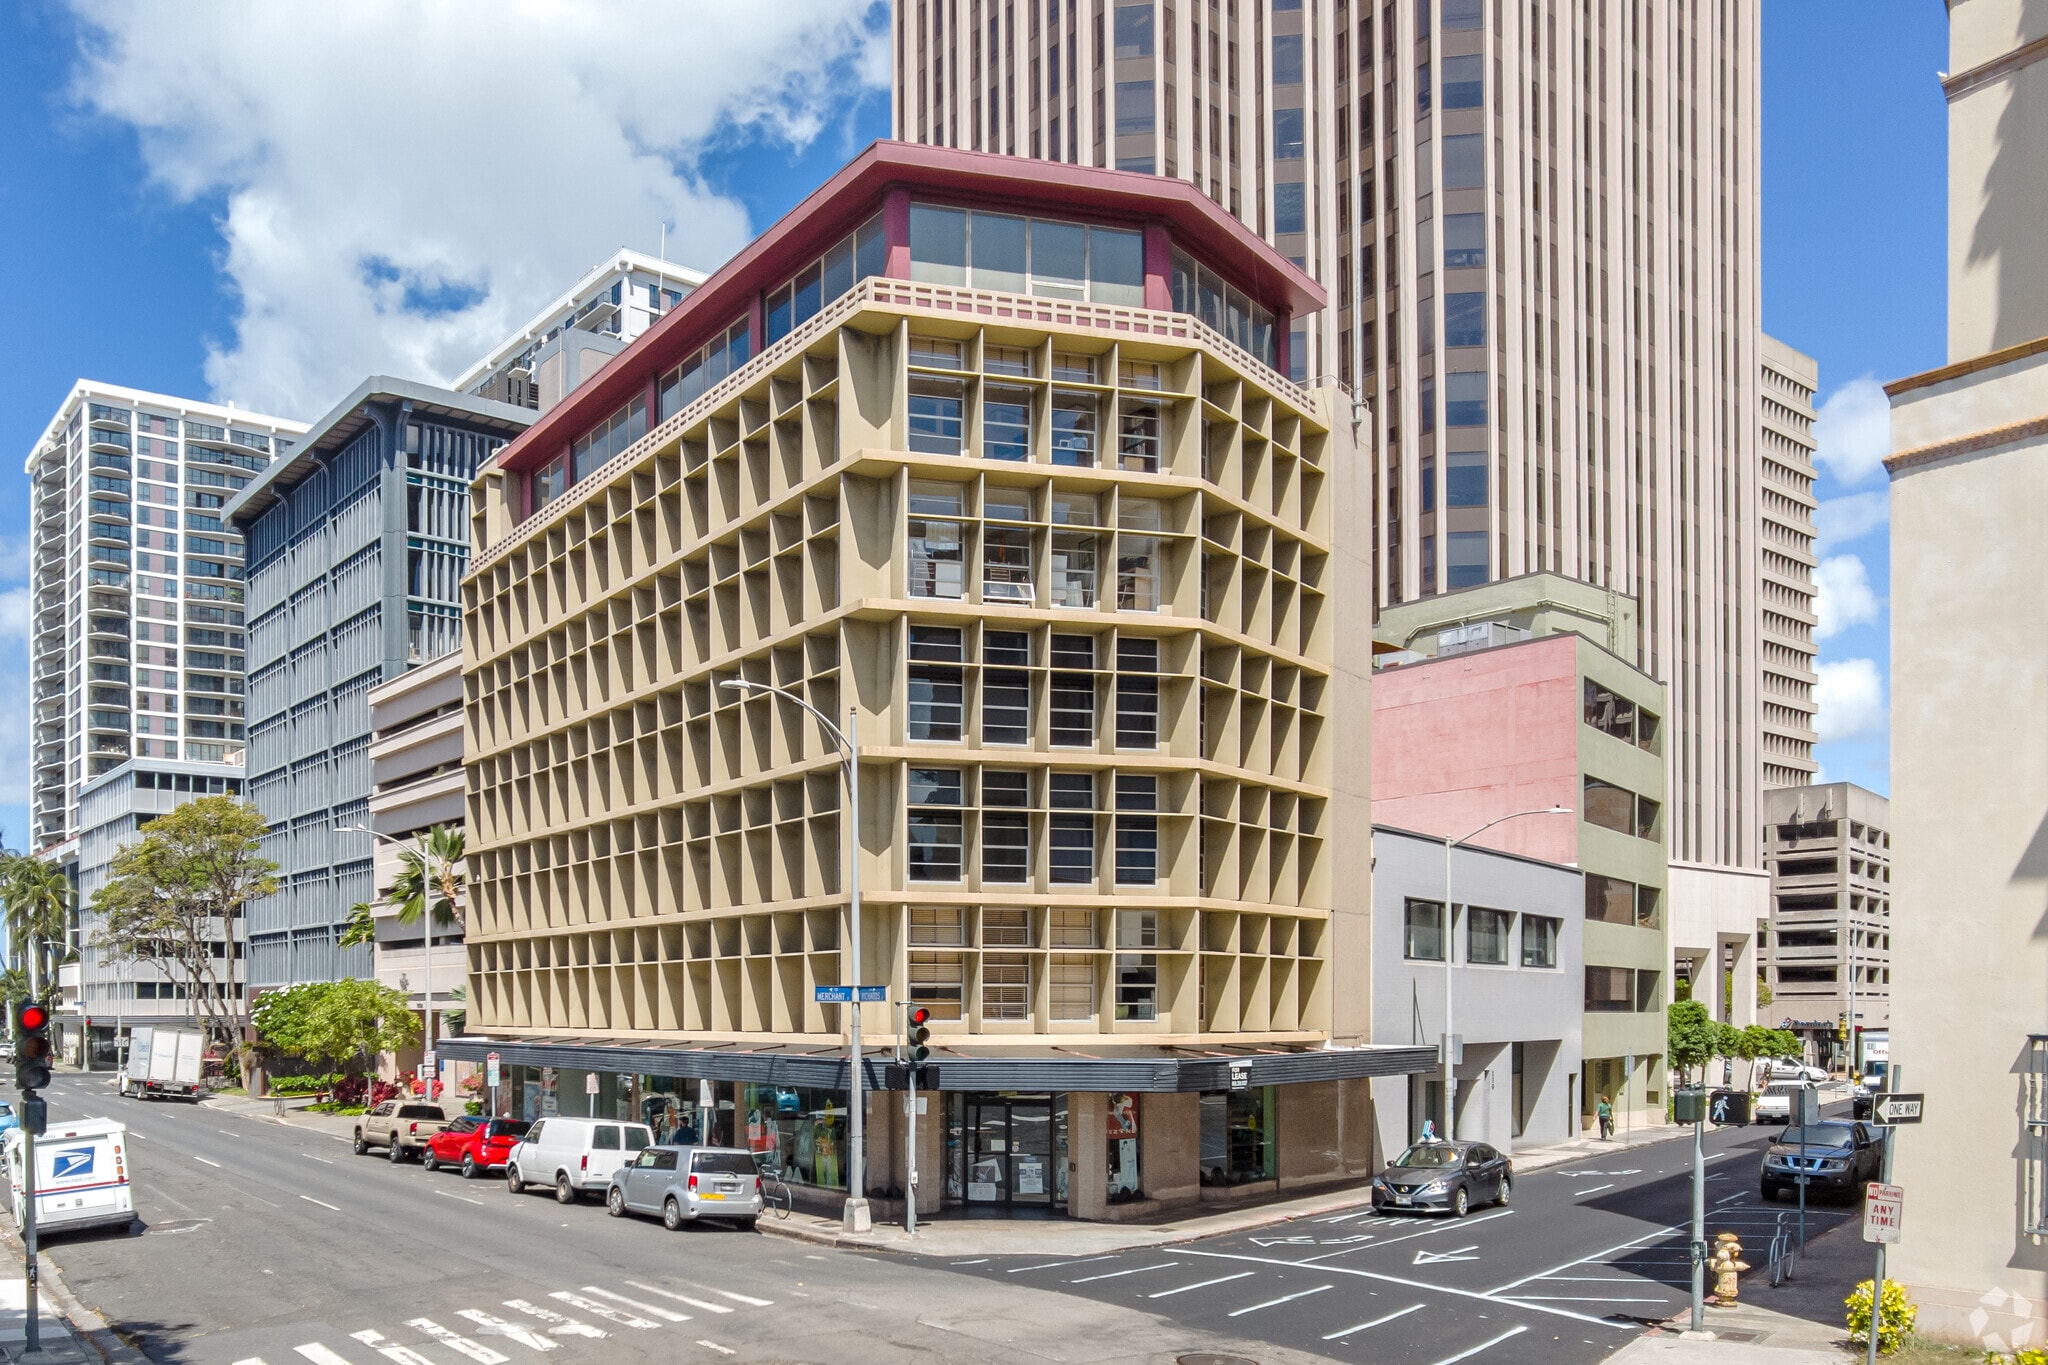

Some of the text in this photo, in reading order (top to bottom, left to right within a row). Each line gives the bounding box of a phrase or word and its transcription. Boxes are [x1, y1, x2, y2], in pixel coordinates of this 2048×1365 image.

[817, 992, 845, 1000] MERCHANT
[1792, 1020, 1833, 1029] Domino's
[1889, 1102, 1920, 1116] ONE WAY
[1868, 1186, 1901, 1198] NO PARKING
[1873, 1204, 1894, 1215] ANY
[1870, 1215, 1895, 1227] TIME
